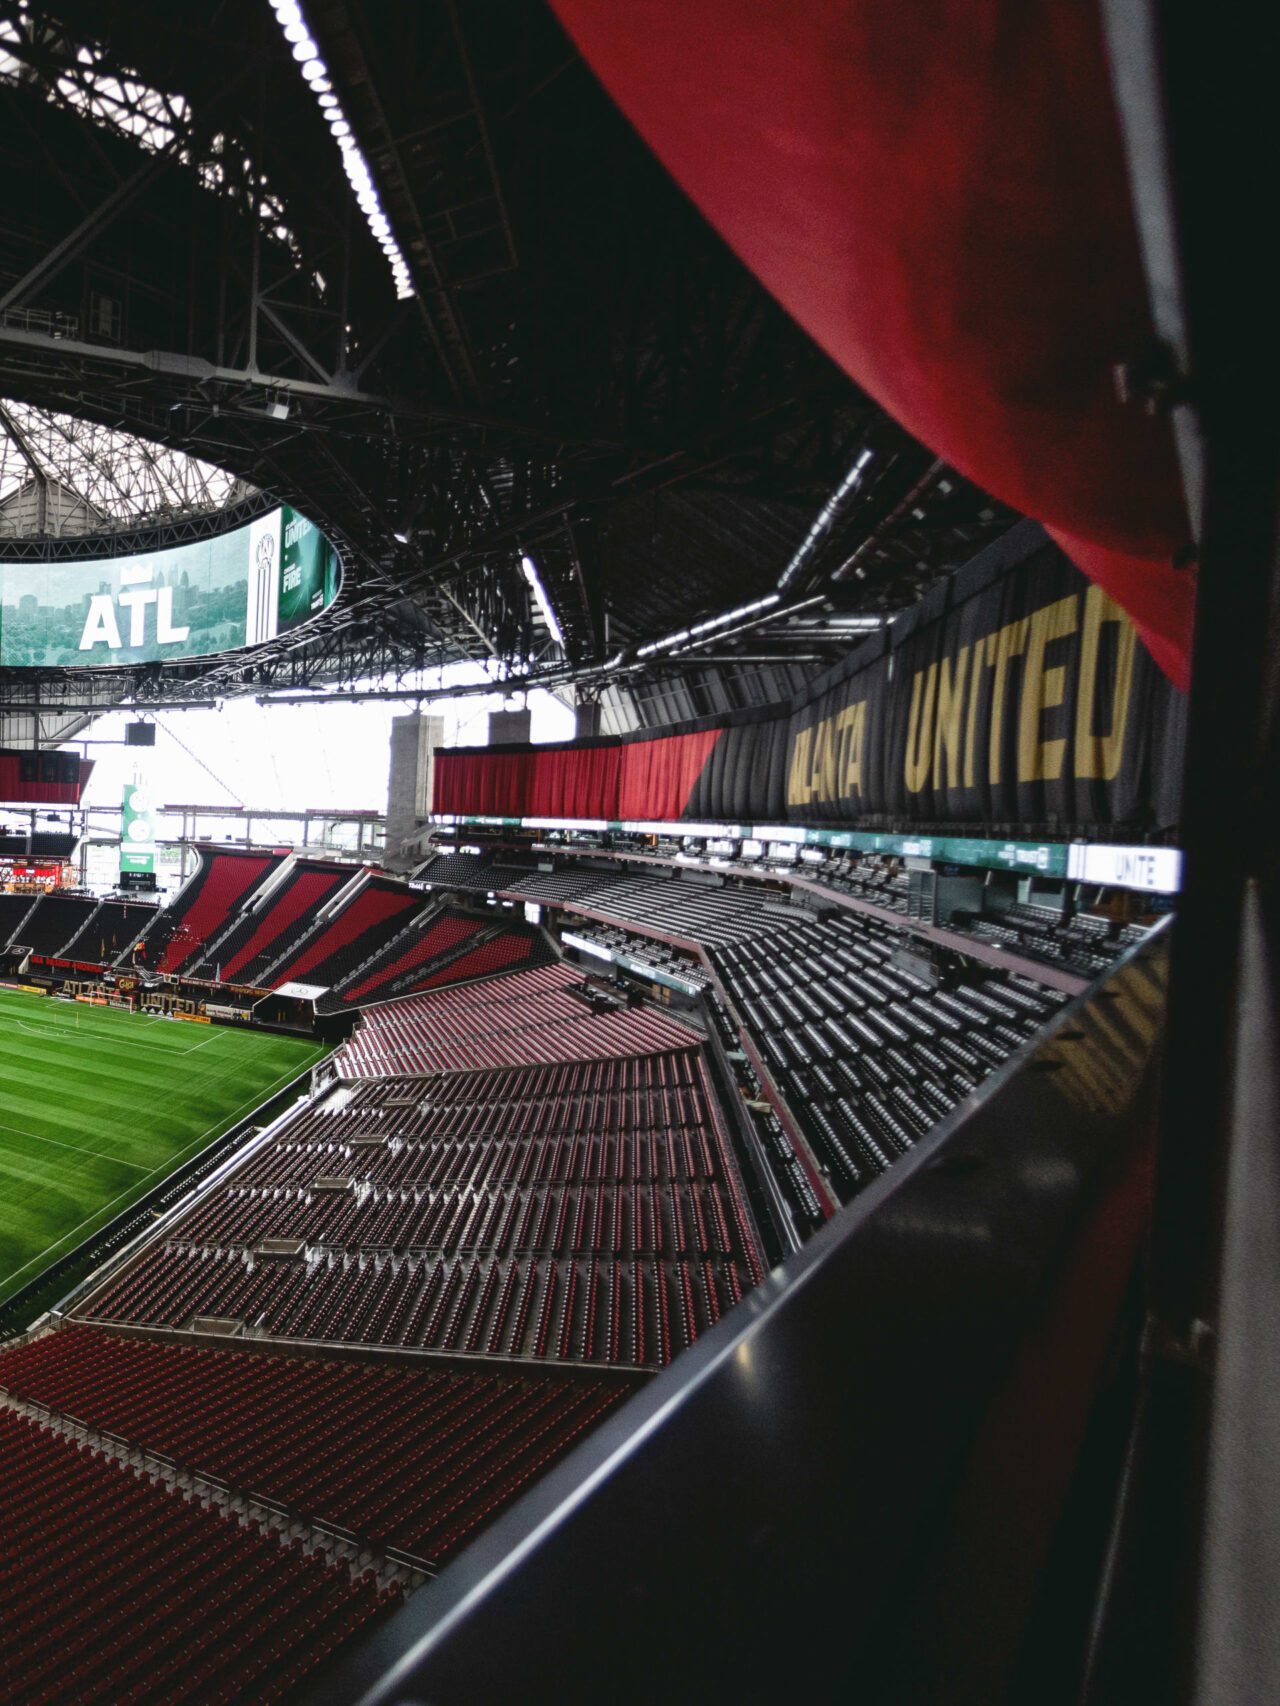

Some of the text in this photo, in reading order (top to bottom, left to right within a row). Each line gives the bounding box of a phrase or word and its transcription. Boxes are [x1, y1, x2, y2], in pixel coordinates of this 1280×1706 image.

[78, 586, 191, 651] ATL
[904, 582, 1138, 794] UNITED
[140, 992, 195, 1016] UNITED
